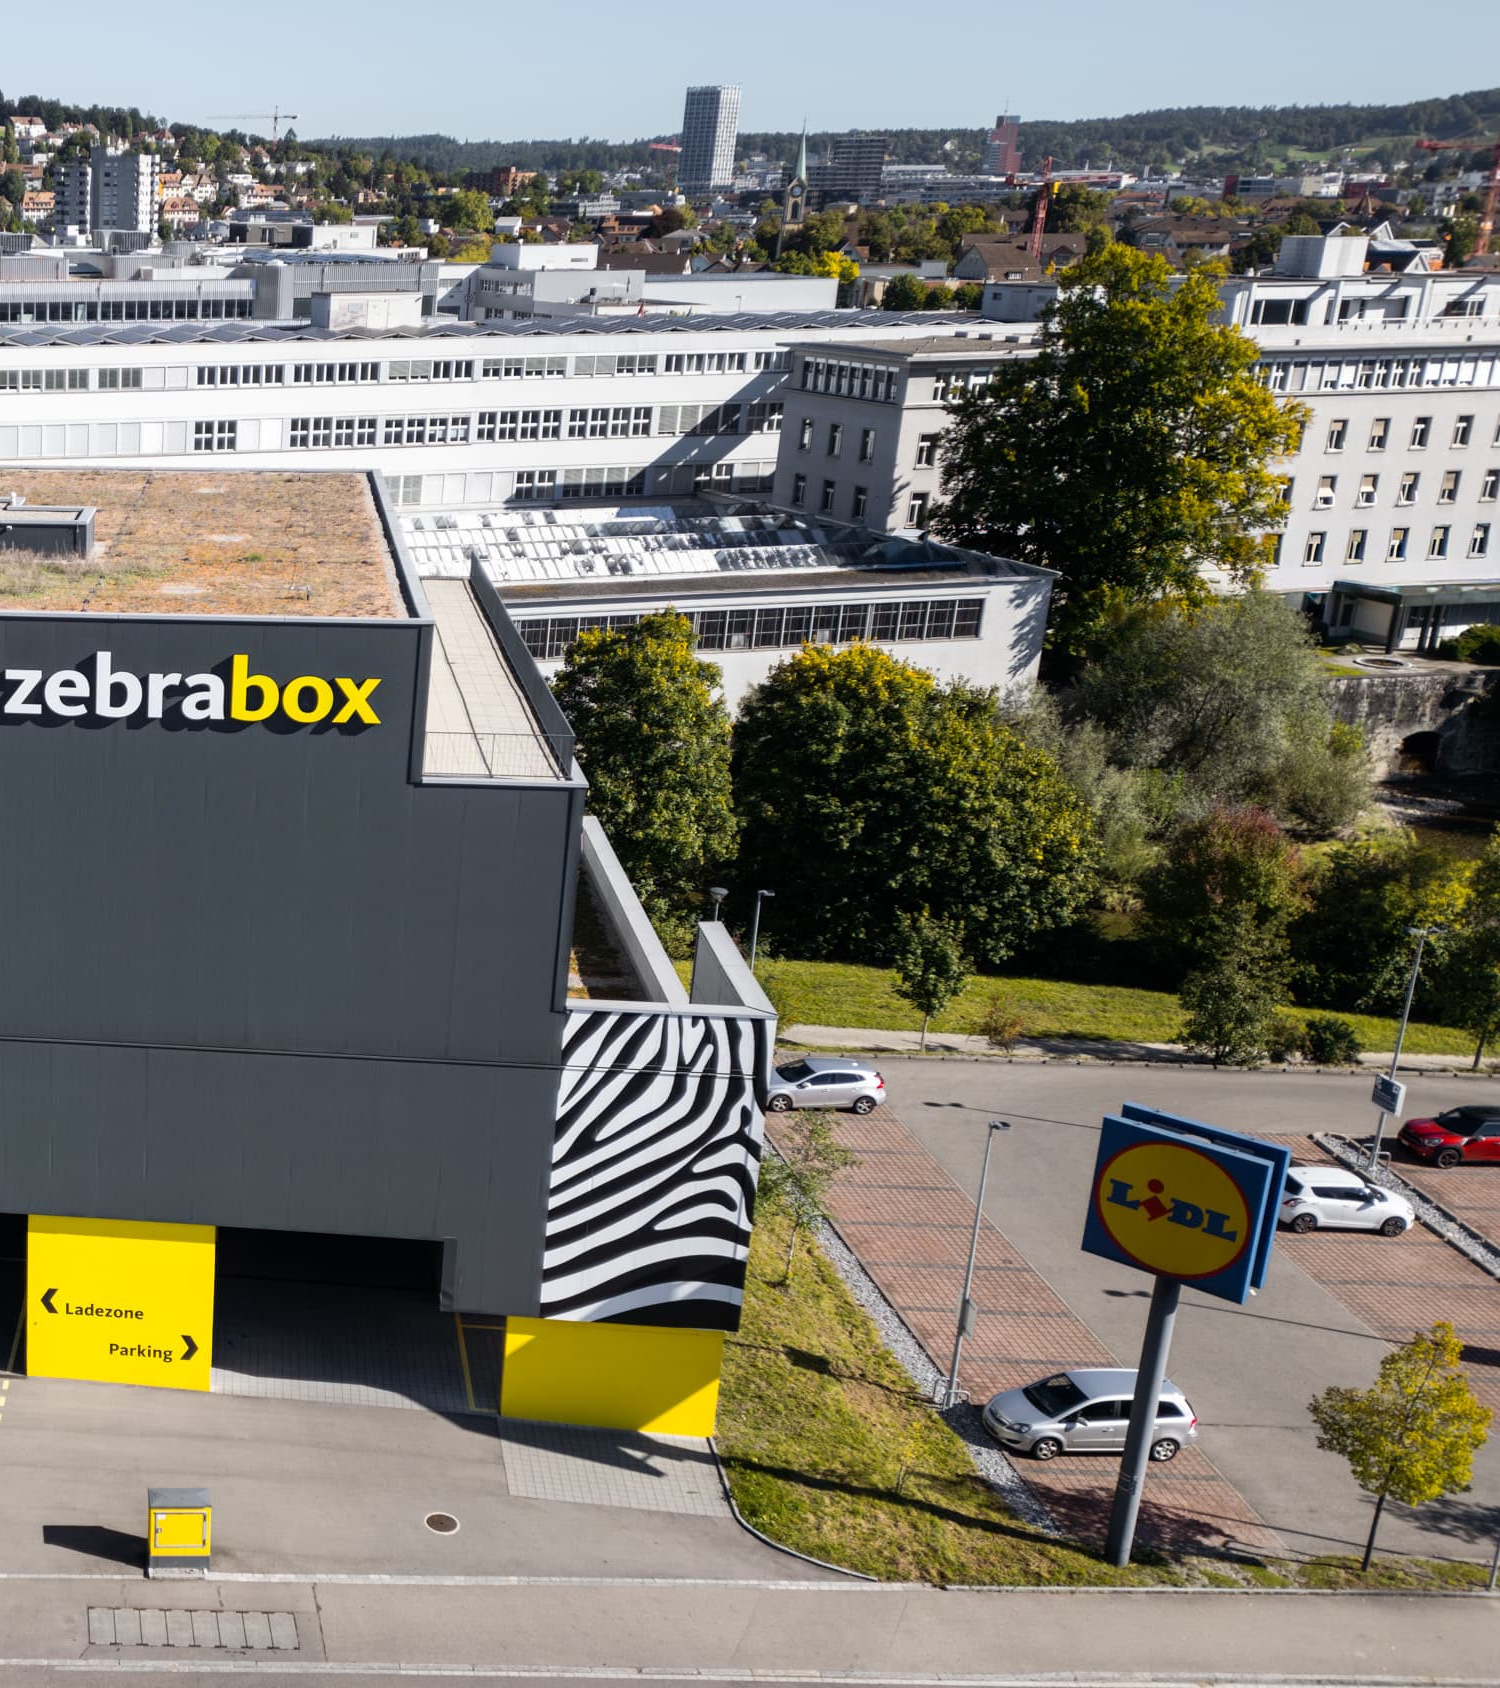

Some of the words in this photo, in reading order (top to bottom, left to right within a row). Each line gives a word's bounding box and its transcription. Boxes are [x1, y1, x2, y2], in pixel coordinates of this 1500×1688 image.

[3, 651, 383, 724] zebrabox
[65, 1302, 144, 1319] Ladezone
[109, 1343, 173, 1363] Parking
